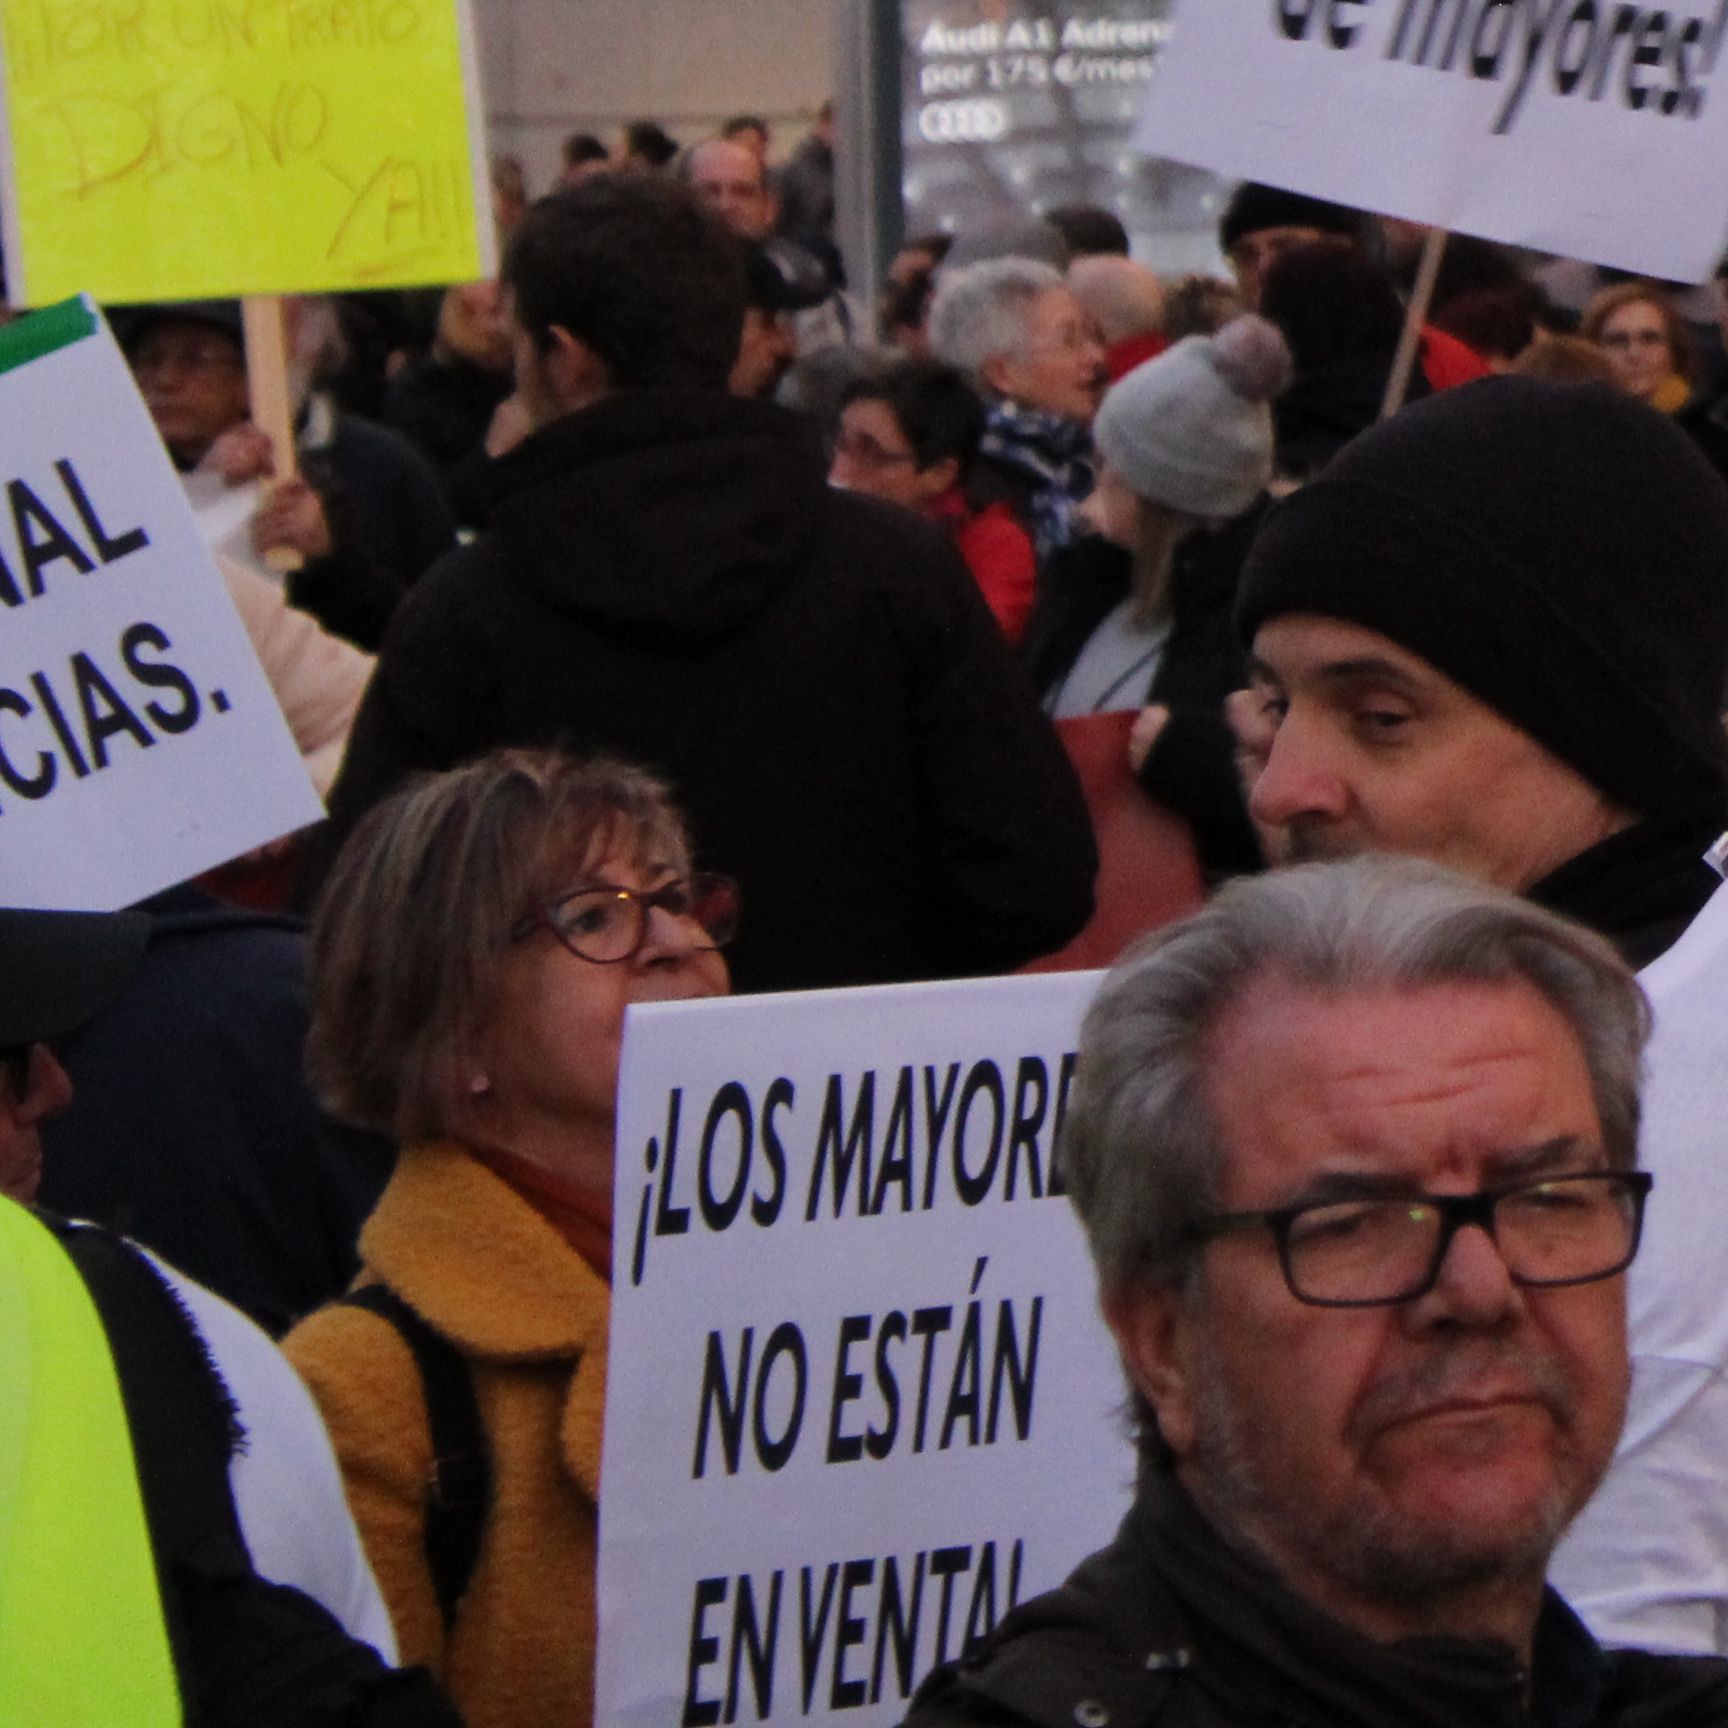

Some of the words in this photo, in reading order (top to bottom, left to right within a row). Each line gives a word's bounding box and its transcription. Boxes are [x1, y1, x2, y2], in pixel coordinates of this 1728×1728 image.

[920, 19, 1000, 54] Audi
[631, 1076, 796, 1287] ¡LOS
[691, 1321, 809, 1481] NO
[826, 1256, 1044, 1465] ESTÁN
[681, 1569, 785, 1728] EN
